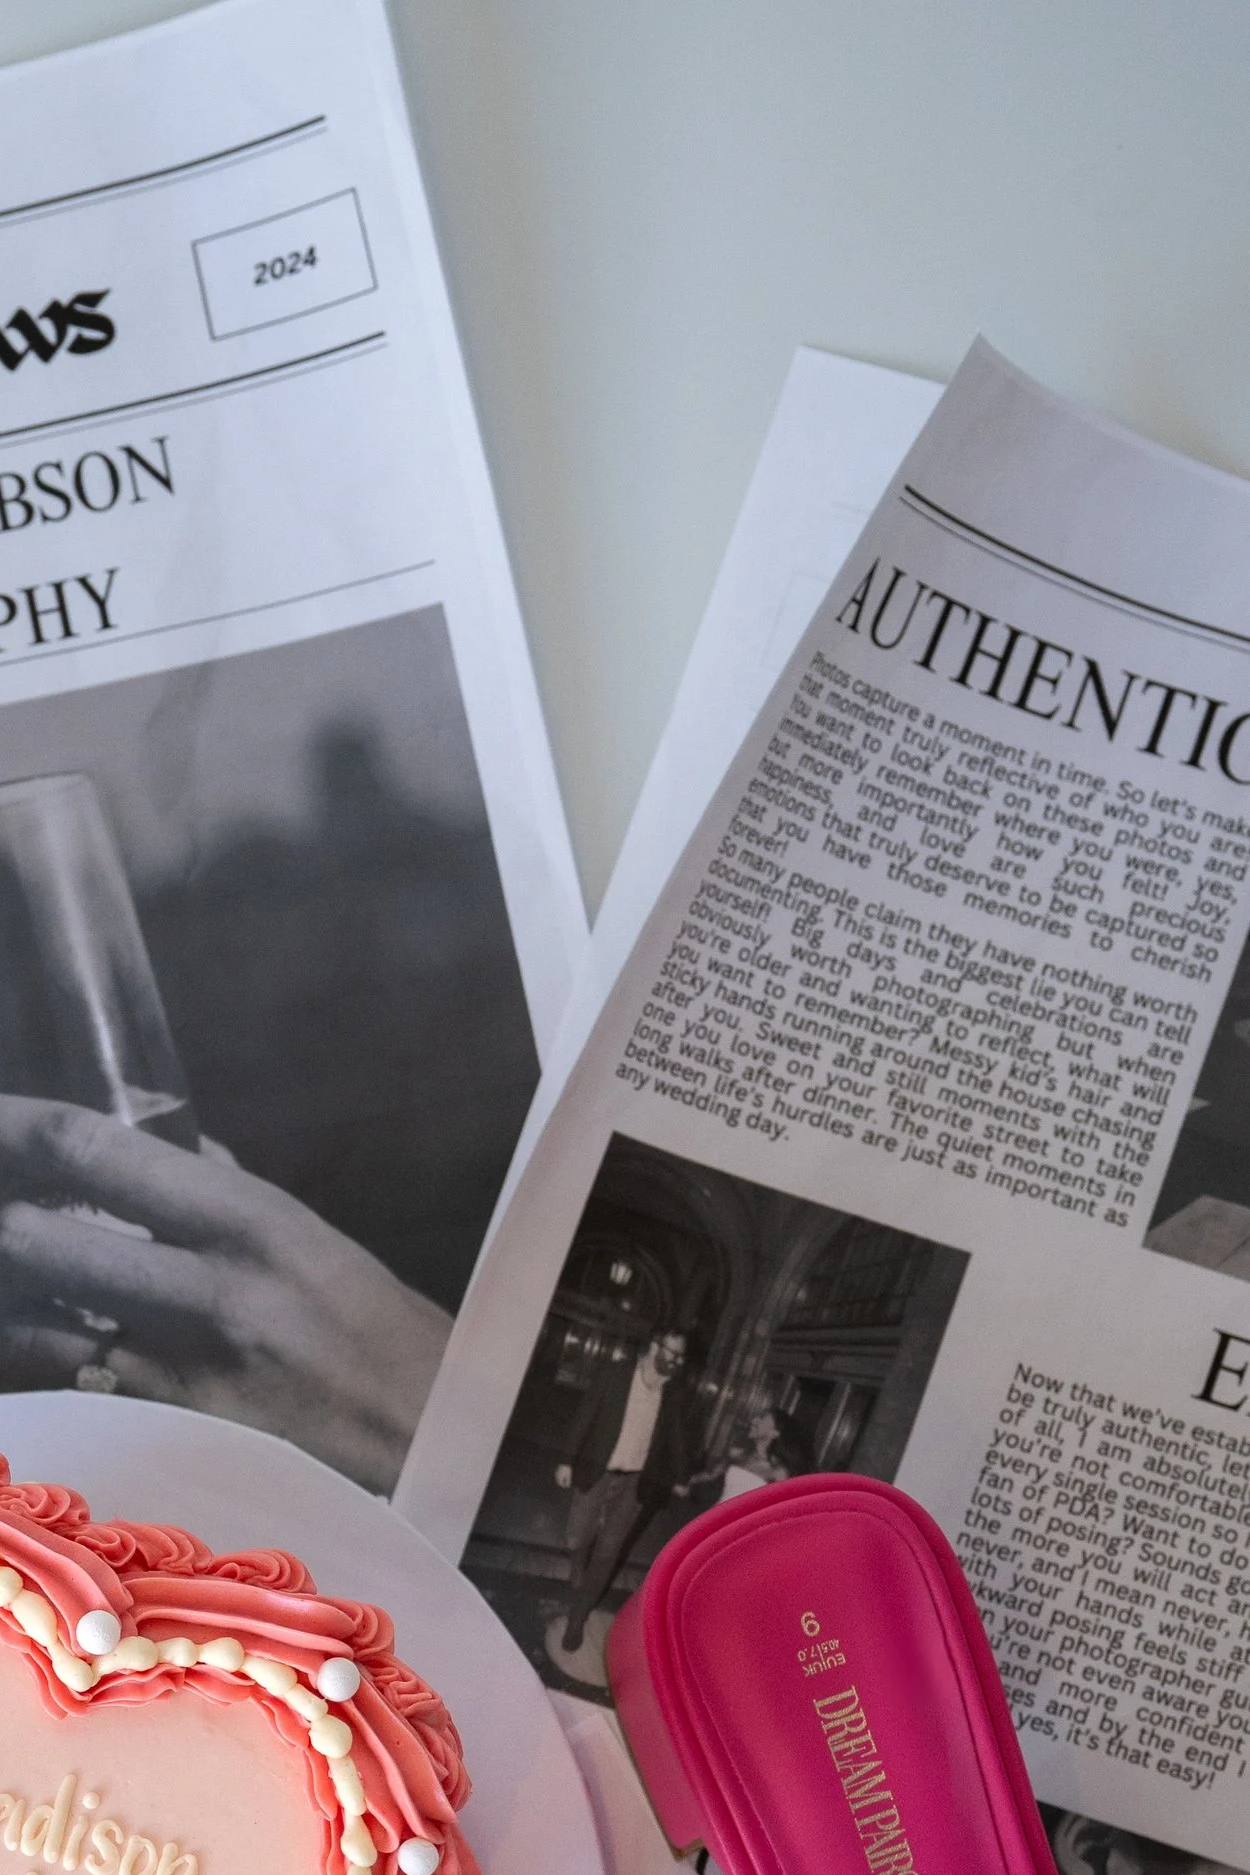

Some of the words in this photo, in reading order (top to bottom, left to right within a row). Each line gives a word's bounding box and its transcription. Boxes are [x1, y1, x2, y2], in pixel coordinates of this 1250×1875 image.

[254, 246, 317, 286] 2024
[615, 1063, 651, 1092] any
[653, 1077, 743, 1129] wedding
[623, 1038, 708, 1088] between
[771, 1094, 855, 1139] hurdles
[861, 1130, 898, 1153] are
[900, 1138, 949, 1170] just
[952, 1159, 977, 1179] as
[984, 1164, 1098, 1218] important
[1103, 1208, 1128, 1227] as
[1006, 1383, 1035, 1409] be
[1042, 1396, 1097, 1436] truly
[1013, 1363, 1065, 1395] Now
[1069, 1383, 1116, 1413] that
[998, 1407, 1026, 1427] of
[1078, 1429, 1088, 1449] I
[1096, 1443, 1132, 1464] am
[1070, 1455, 1111, 1480] not
[977, 1465, 1014, 1494] fan
[1021, 1481, 1049, 1503] of
[1053, 1491, 1116, 1525] PDA?
[1122, 1513, 1180, 1549] Want
[1187, 1536, 1212, 1559] to
[1219, 1547, 1249, 1571] do
[981, 1451, 1049, 1490] every
[1052, 1471, 1119, 1513] single
[1122, 1494, 1207, 1534] session
[1211, 1524, 1239, 1544] so
[964, 1508, 1002, 1536] the
[1010, 1529, 1071, 1558] more
[1076, 1551, 1122, 1576] you
[1133, 1567, 1172, 1593] will
[1180, 1583, 1219, 1608] act
[970, 1487, 1013, 1517] lots
[1018, 1506, 1045, 1525] of
[1044, 1516, 1135, 1557] posing?
[1137, 1542, 1222, 1586] Sounds
[1030, 1557, 1078, 1583] and
[1080, 1569, 1090, 1587] I
[1094, 1579, 1157, 1609] mean
[813, 1685, 893, 1813] DREAM
